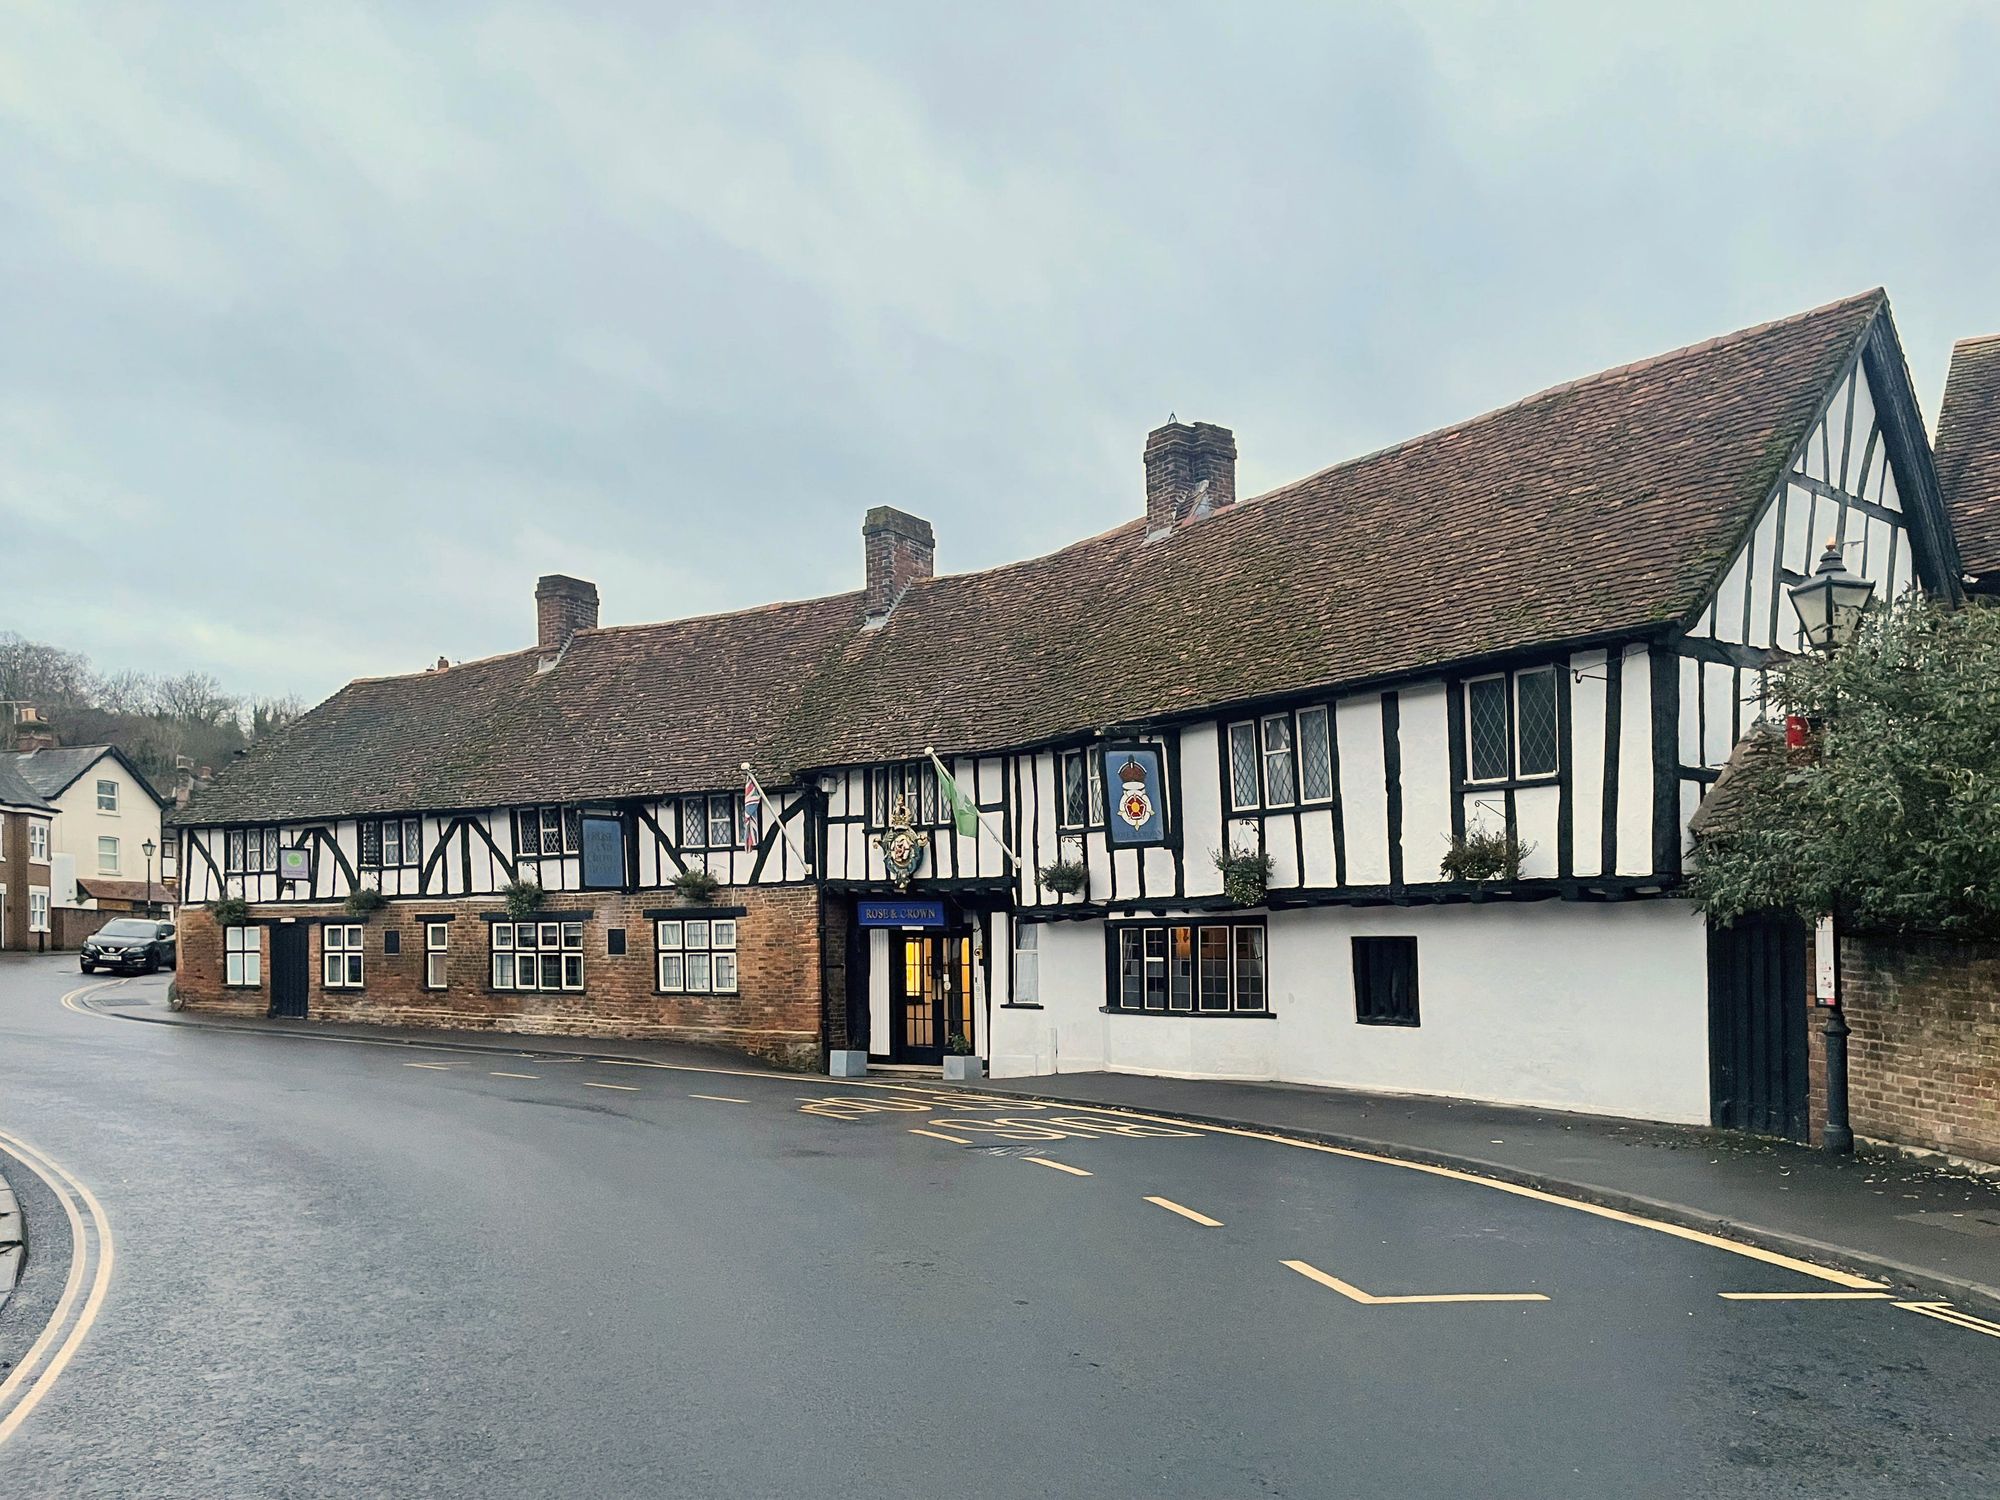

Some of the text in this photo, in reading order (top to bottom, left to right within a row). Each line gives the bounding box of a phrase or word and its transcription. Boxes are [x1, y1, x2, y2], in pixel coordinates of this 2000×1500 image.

[865, 908, 936, 919] ROSE & CROWN
[794, 1096, 1047, 1113] STOP
[928, 1116, 1206, 1140] BUS
